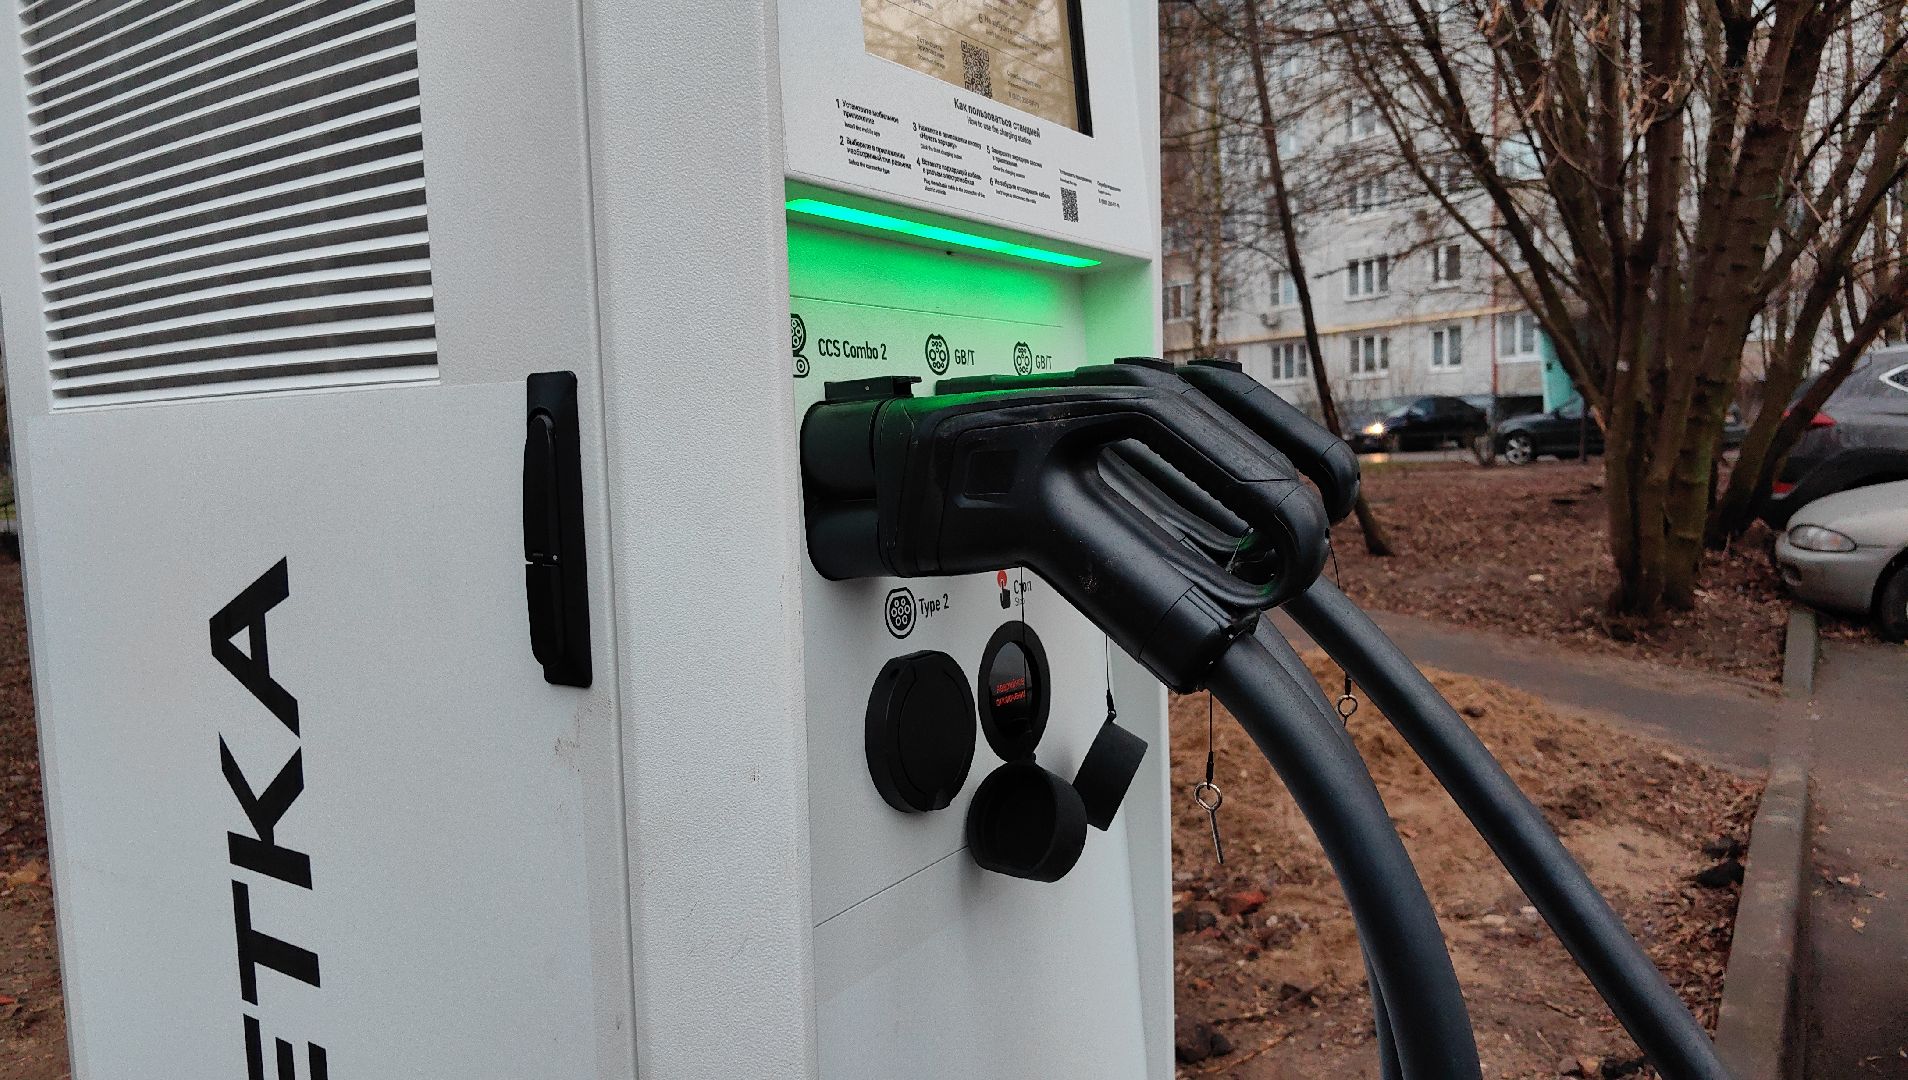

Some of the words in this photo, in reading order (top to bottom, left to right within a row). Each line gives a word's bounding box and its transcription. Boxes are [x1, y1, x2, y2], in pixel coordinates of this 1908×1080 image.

[835, 98, 840, 109] 1
[953, 97, 967, 112] Как
[968, 105, 1011, 128] пользоваться
[1013, 120, 1040, 139] станцией
[912, 121, 917, 131] 3
[839, 135, 844, 146] 2
[986, 144, 990, 154] 5
[916, 156, 920, 166] 4
[989, 177, 993, 186] 6
[818, 339, 841, 358] CCS
[843, 341, 879, 360] Combo
[880, 344, 887, 360] 2
[954, 350, 975, 366] GB/T
[1035, 354, 1052, 370] GB/T
[919, 597, 941, 618] Type
[942, 593, 950, 609] 2
